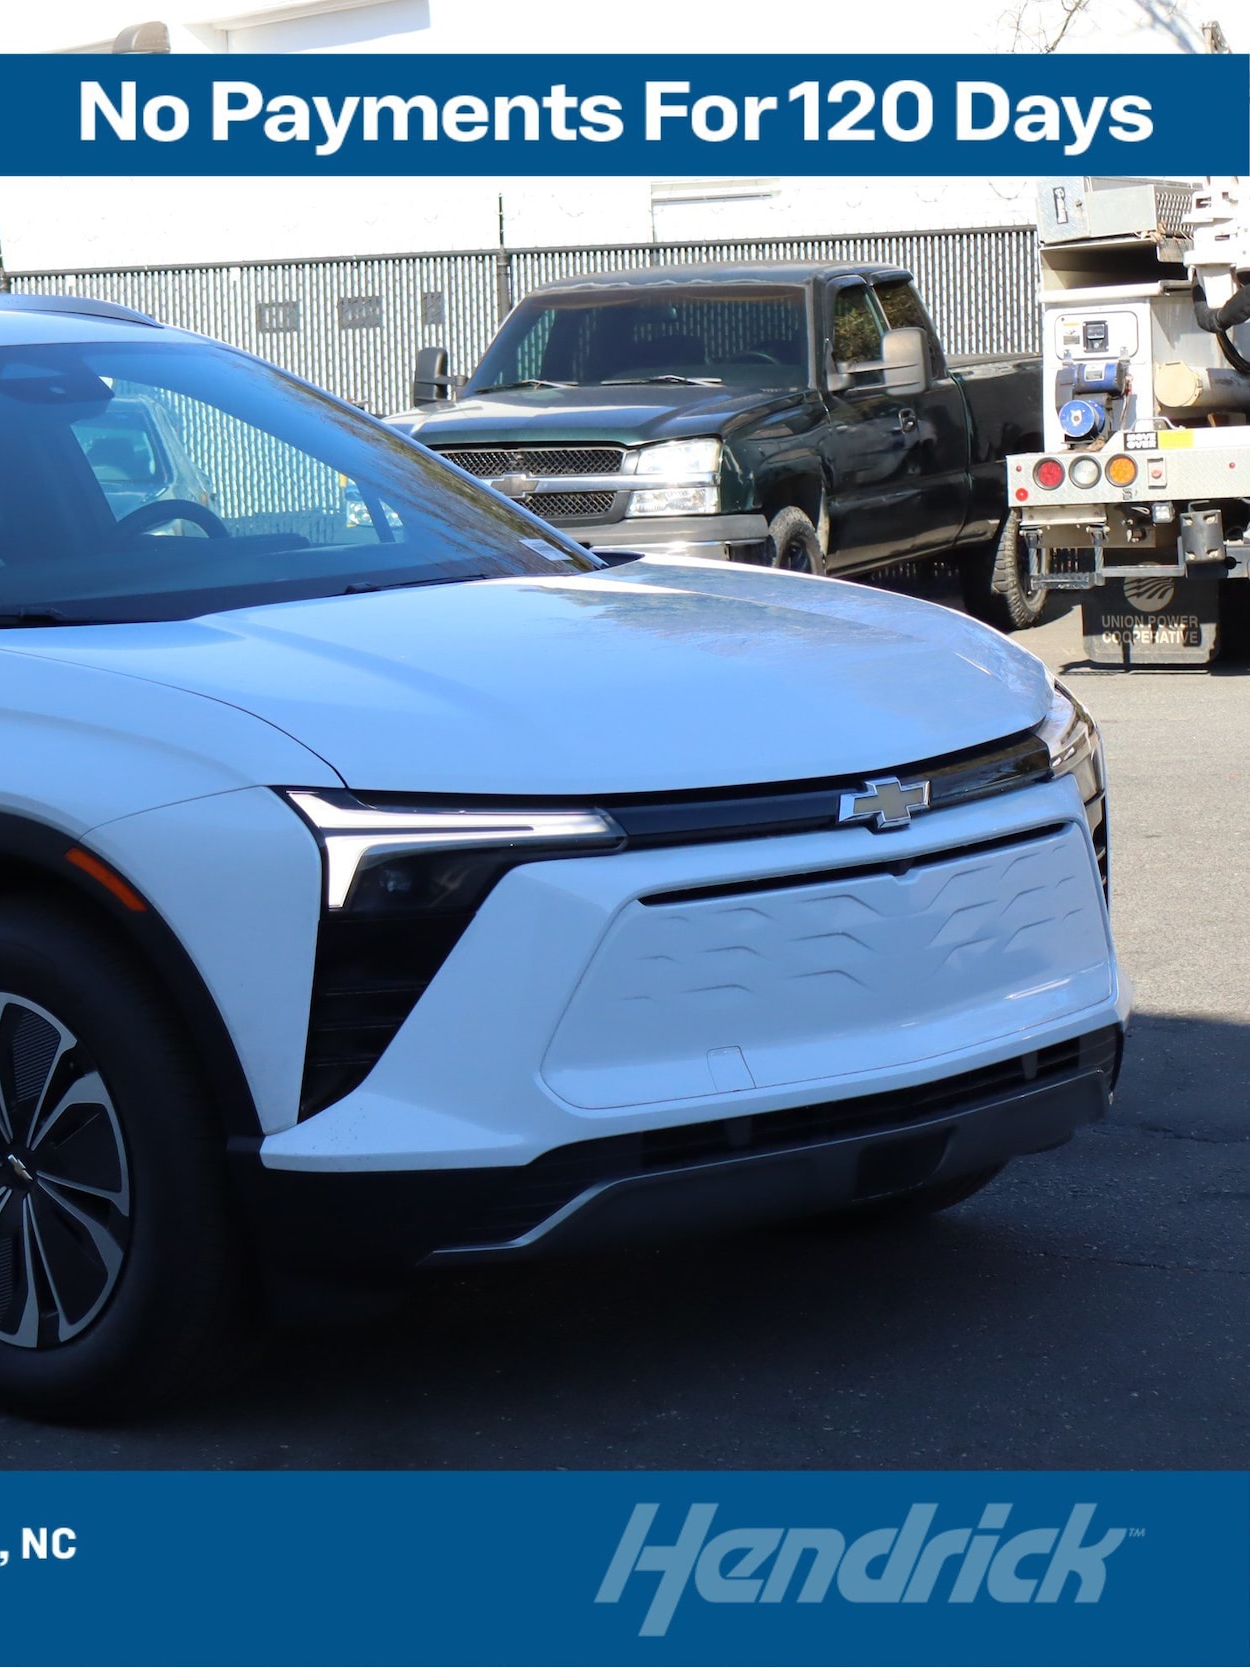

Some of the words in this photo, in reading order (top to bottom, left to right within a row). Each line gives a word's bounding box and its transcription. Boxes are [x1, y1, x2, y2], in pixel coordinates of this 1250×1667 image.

[1126, 440, 1156, 449] OVER
[1102, 615, 1144, 628] UNION
[1148, 615, 1198, 628] POWER
[1102, 630, 1198, 644] COOPERATIVE
